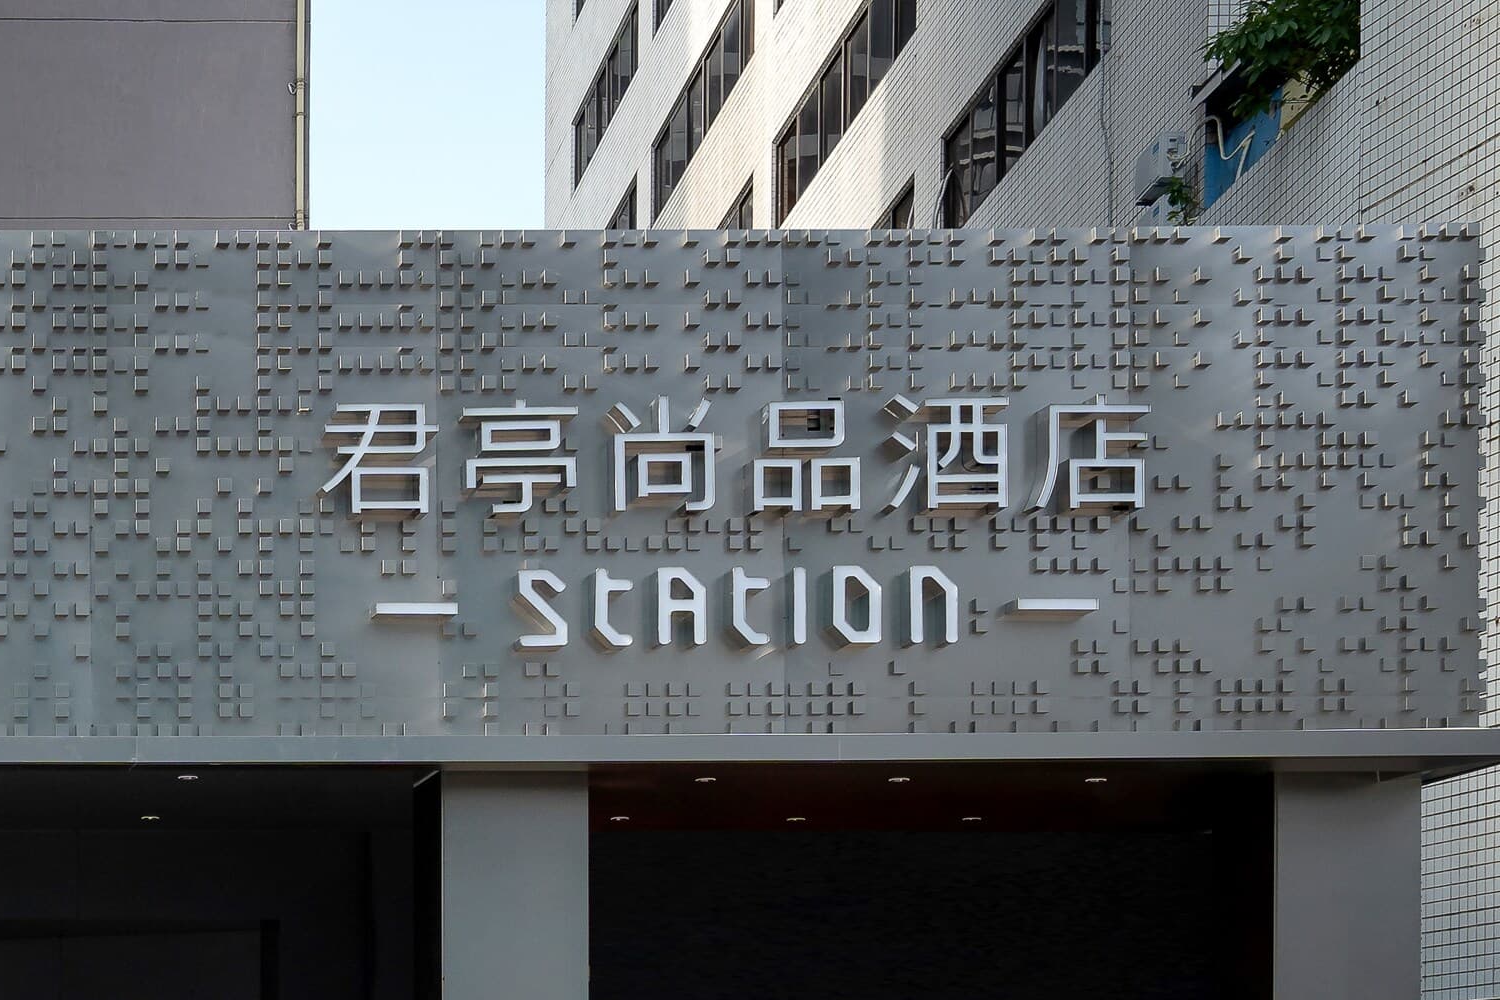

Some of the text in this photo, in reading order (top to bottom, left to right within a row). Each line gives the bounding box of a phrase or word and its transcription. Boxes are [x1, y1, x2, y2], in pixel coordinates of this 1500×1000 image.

[316, 394, 1152, 516] 君亭尚品酒店
